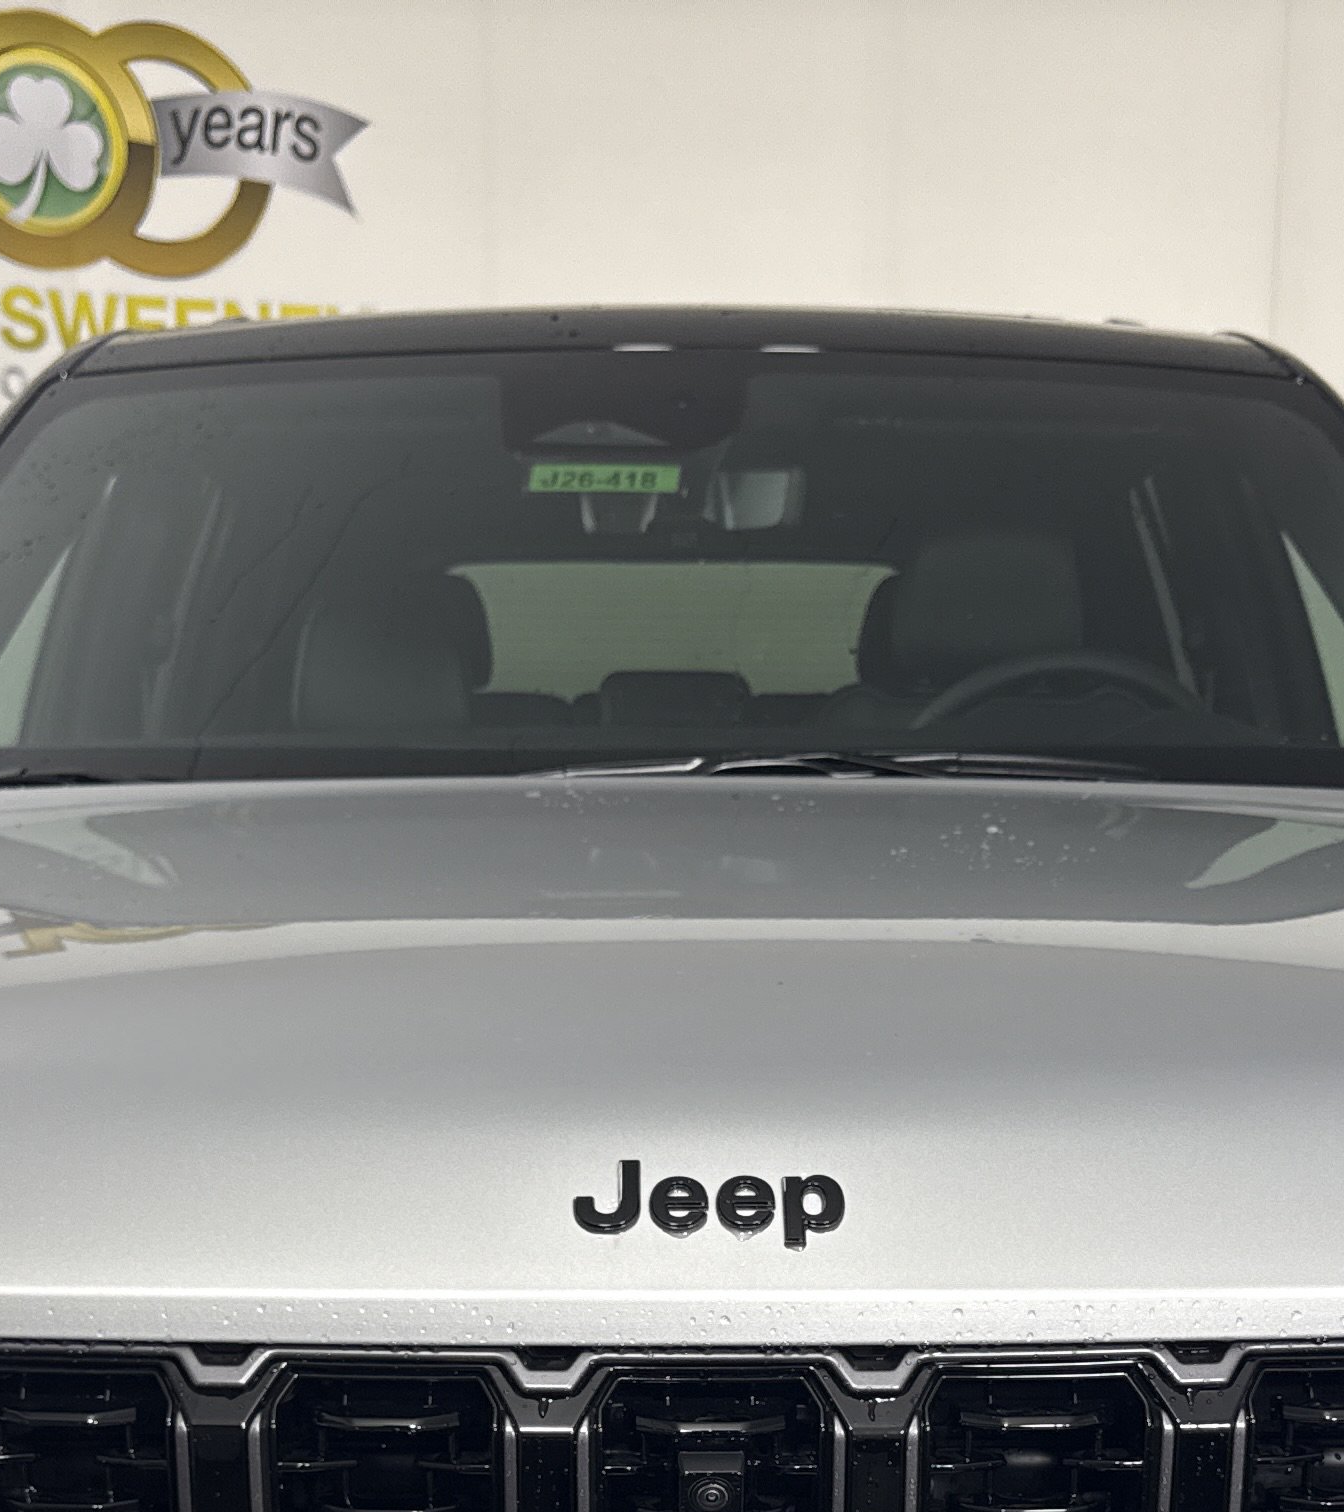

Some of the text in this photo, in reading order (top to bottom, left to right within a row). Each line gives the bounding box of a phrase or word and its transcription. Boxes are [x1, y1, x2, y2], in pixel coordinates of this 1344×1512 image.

[169, 104, 323, 166] years
[539, 470, 658, 490] J26-418
[572, 1159, 846, 1251] Jeep
